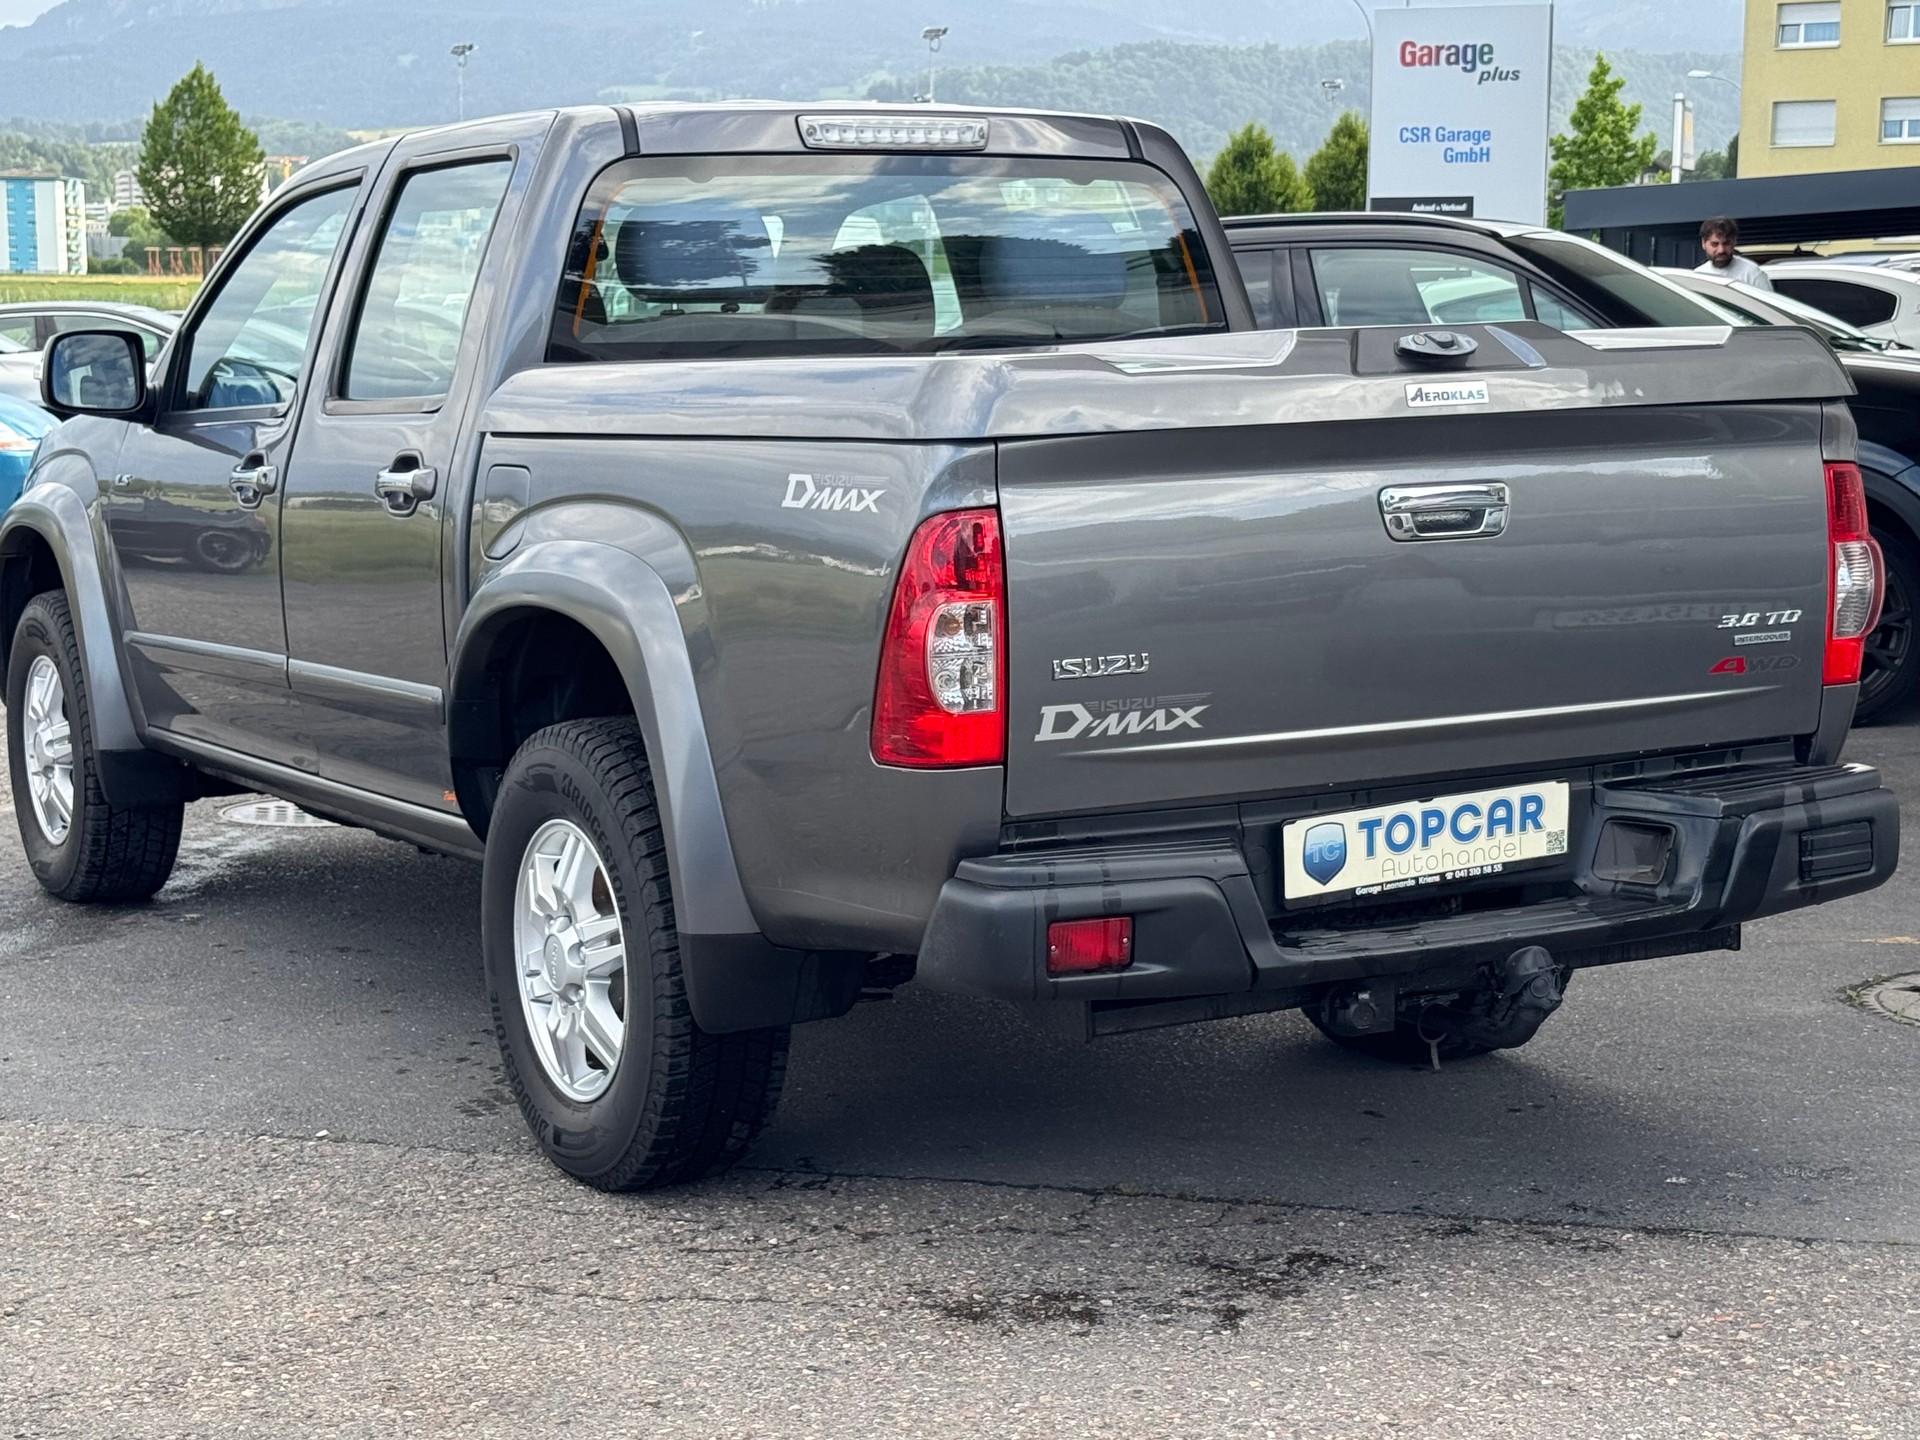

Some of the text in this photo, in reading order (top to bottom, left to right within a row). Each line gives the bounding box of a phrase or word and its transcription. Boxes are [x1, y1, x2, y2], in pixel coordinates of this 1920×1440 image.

[1400, 41, 1494, 73] Garage
[1477, 66, 1520, 85] plus
[1400, 126, 1491, 145] CSR Garage
[1443, 147, 1490, 163] GmbH
[1409, 387, 1485, 402] AEROKLAS
[1766, 609, 1802, 625] TD
[1052, 652, 1150, 681] ISUZU
[1100, 697, 1156, 712] ISUZU
[1034, 703, 1212, 742] D-MAX
[1357, 794, 1546, 860] TOPCAR
[1309, 840, 1341, 864] TC
[1381, 836, 1524, 879] Autohandel
[1355, 884, 1382, 896] Garage
[1455, 869, 1468, 879] 041
[1469, 867, 1481, 877] 310
